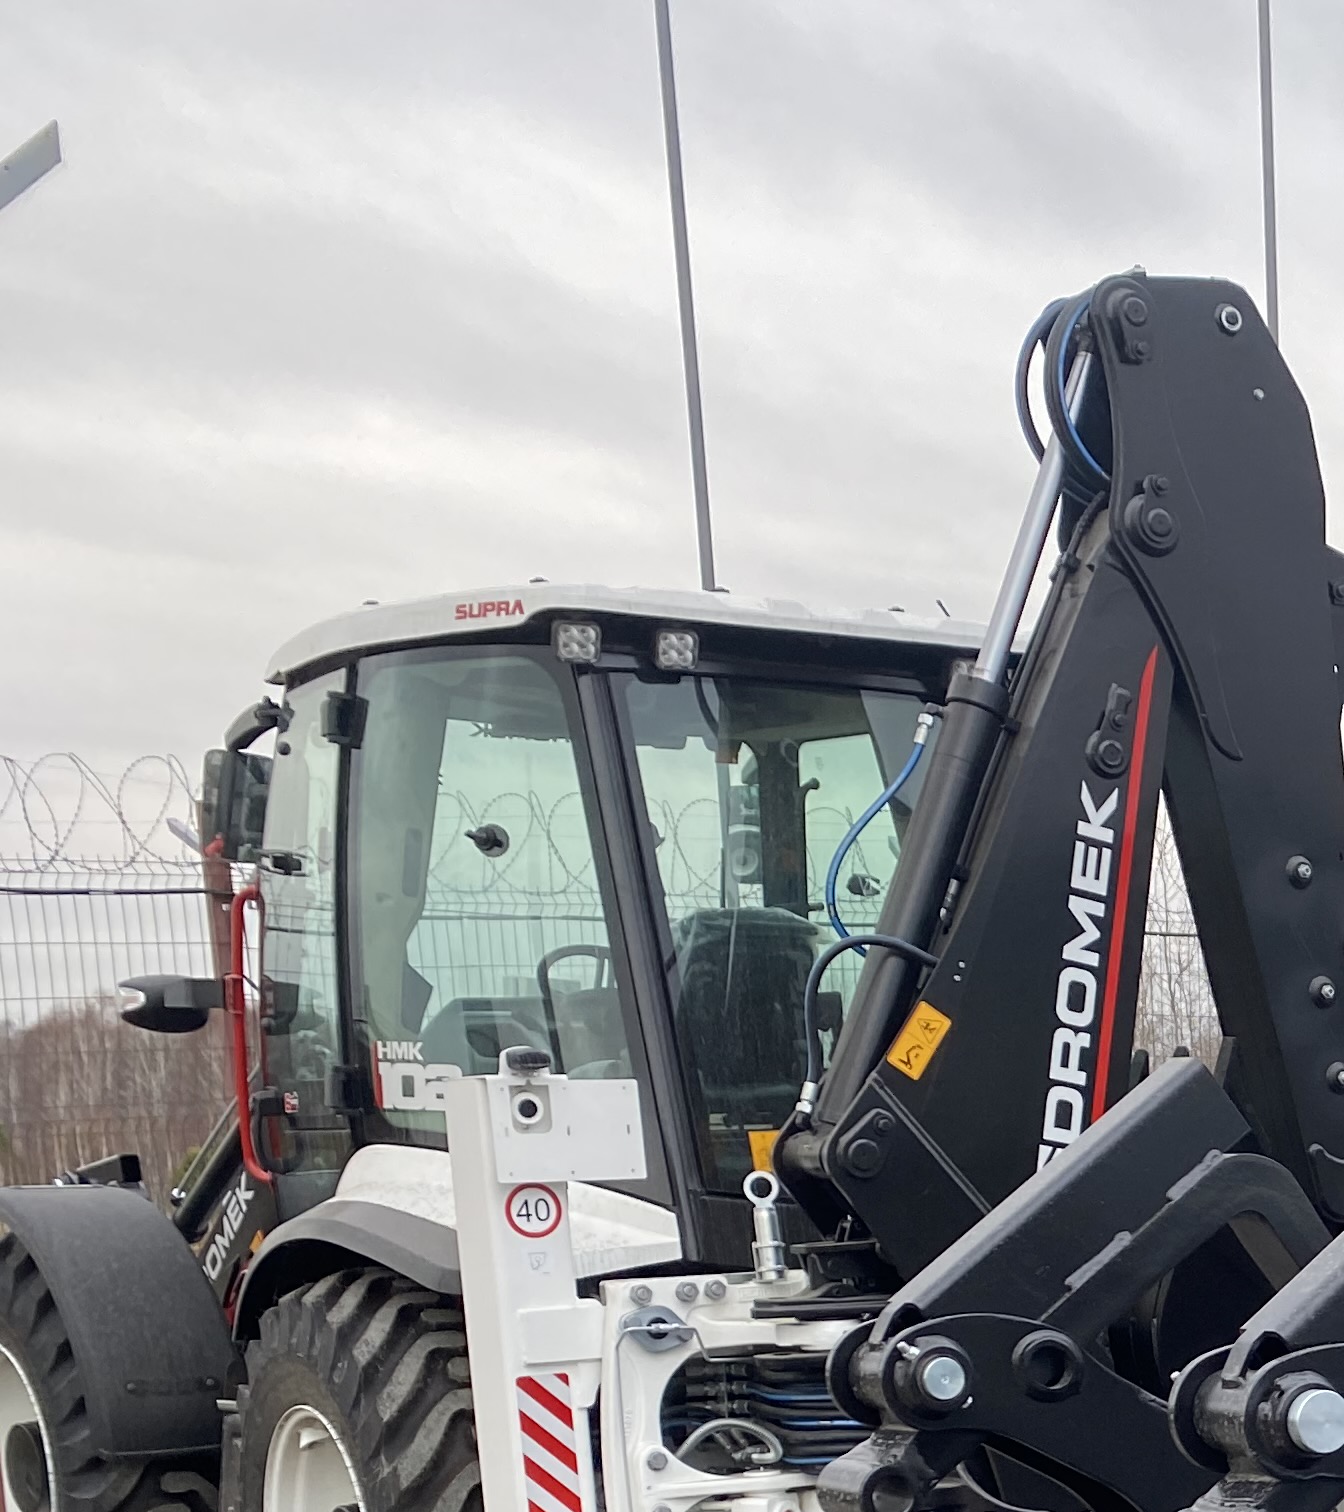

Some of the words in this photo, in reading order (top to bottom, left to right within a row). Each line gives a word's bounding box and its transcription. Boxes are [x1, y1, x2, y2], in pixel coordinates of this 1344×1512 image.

[455, 600, 525, 620] SUPRA
[1036, 780, 1119, 1173] DROMEK
[377, 1041, 424, 1060] HMK
[516, 1198, 551, 1222] 40
[202, 1171, 255, 1285] OMEK
